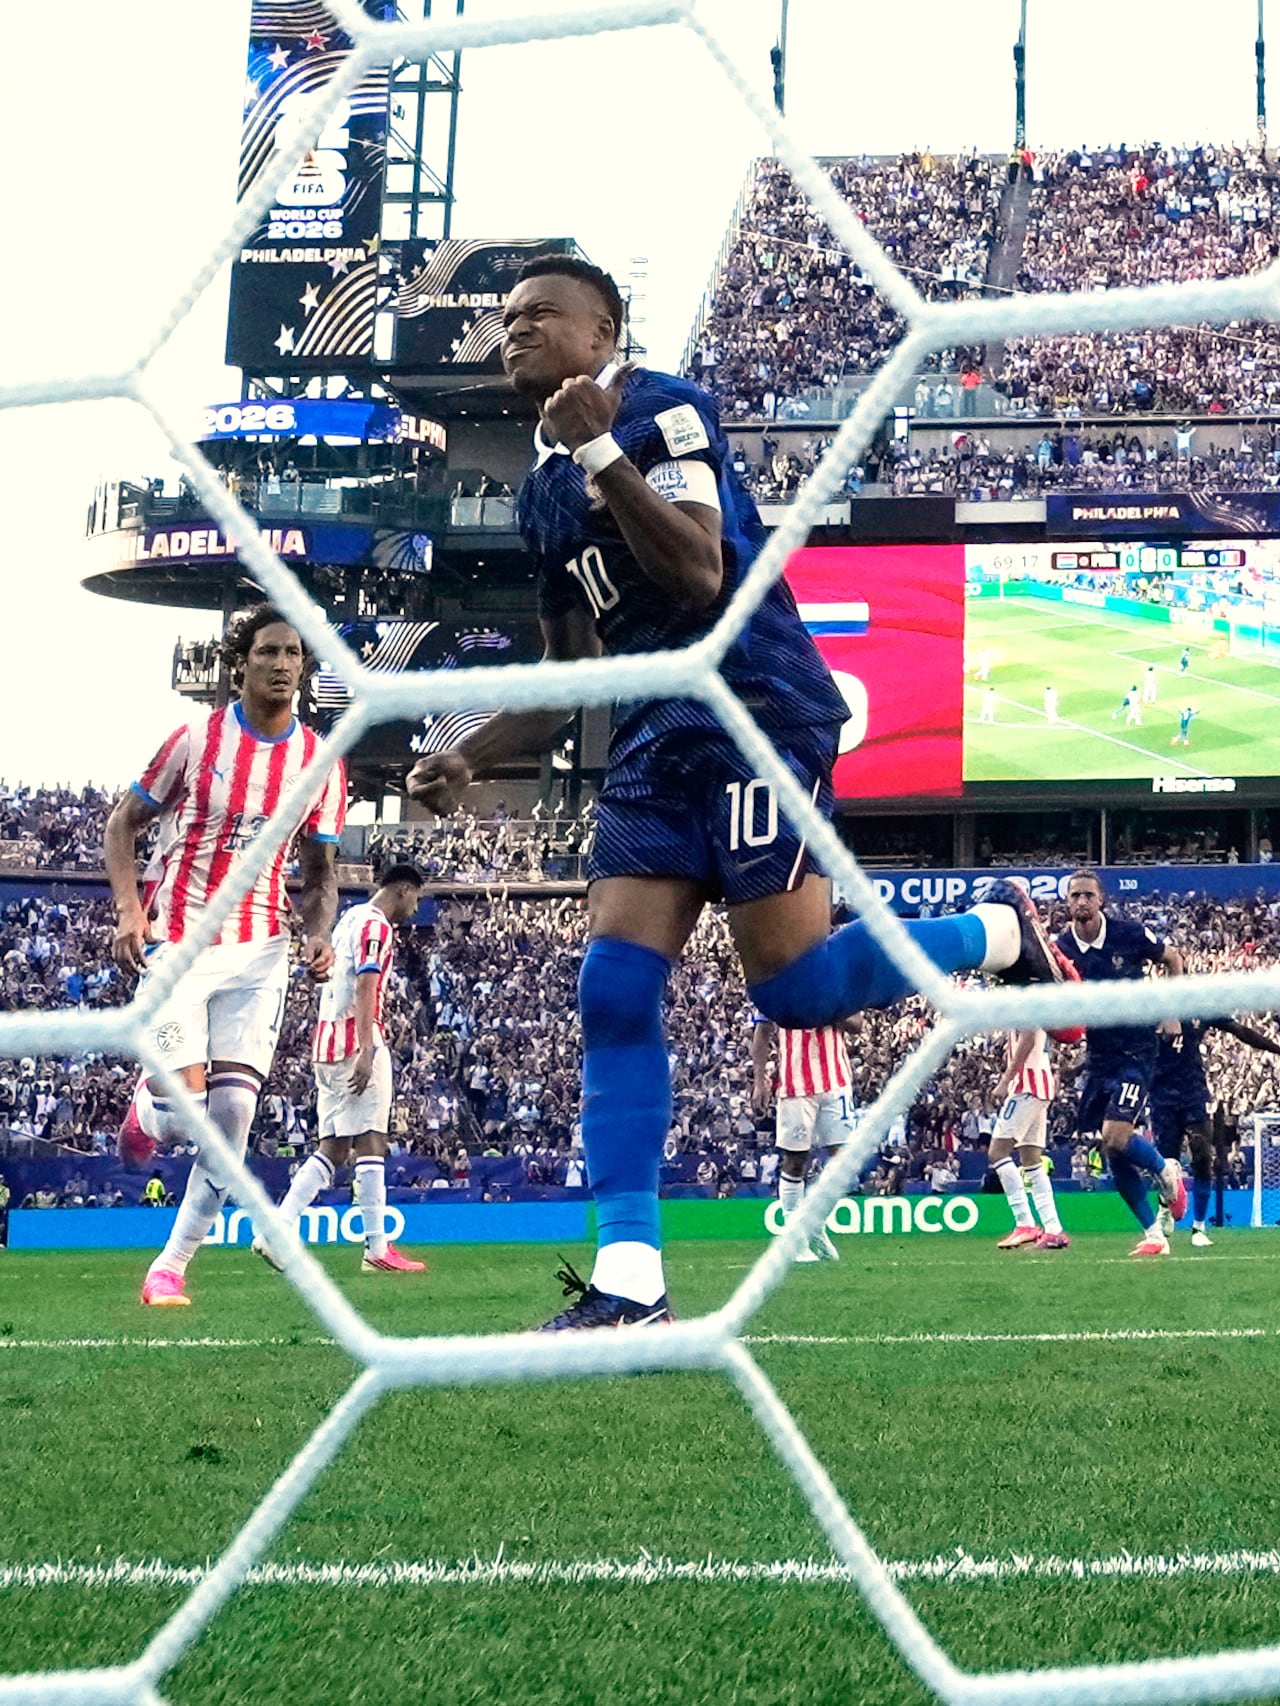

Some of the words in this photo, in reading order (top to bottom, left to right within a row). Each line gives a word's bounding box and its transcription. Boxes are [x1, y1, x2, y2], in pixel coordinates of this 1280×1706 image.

[293, 184, 324, 193] FIFA
[269, 209, 316, 221] WORLD
[317, 208, 344, 220] CUP
[267, 221, 343, 239] 2026
[241, 248, 366, 263] PHILADELPHIA
[1073, 507, 1180, 520] PHILADELPHIA
[565, 545, 621, 619] 10
[725, 778, 778, 851] 10
[901, 877, 967, 904] CUP
[1118, 879, 1138, 890] 130
[1118, 1083, 1140, 1107] 14
